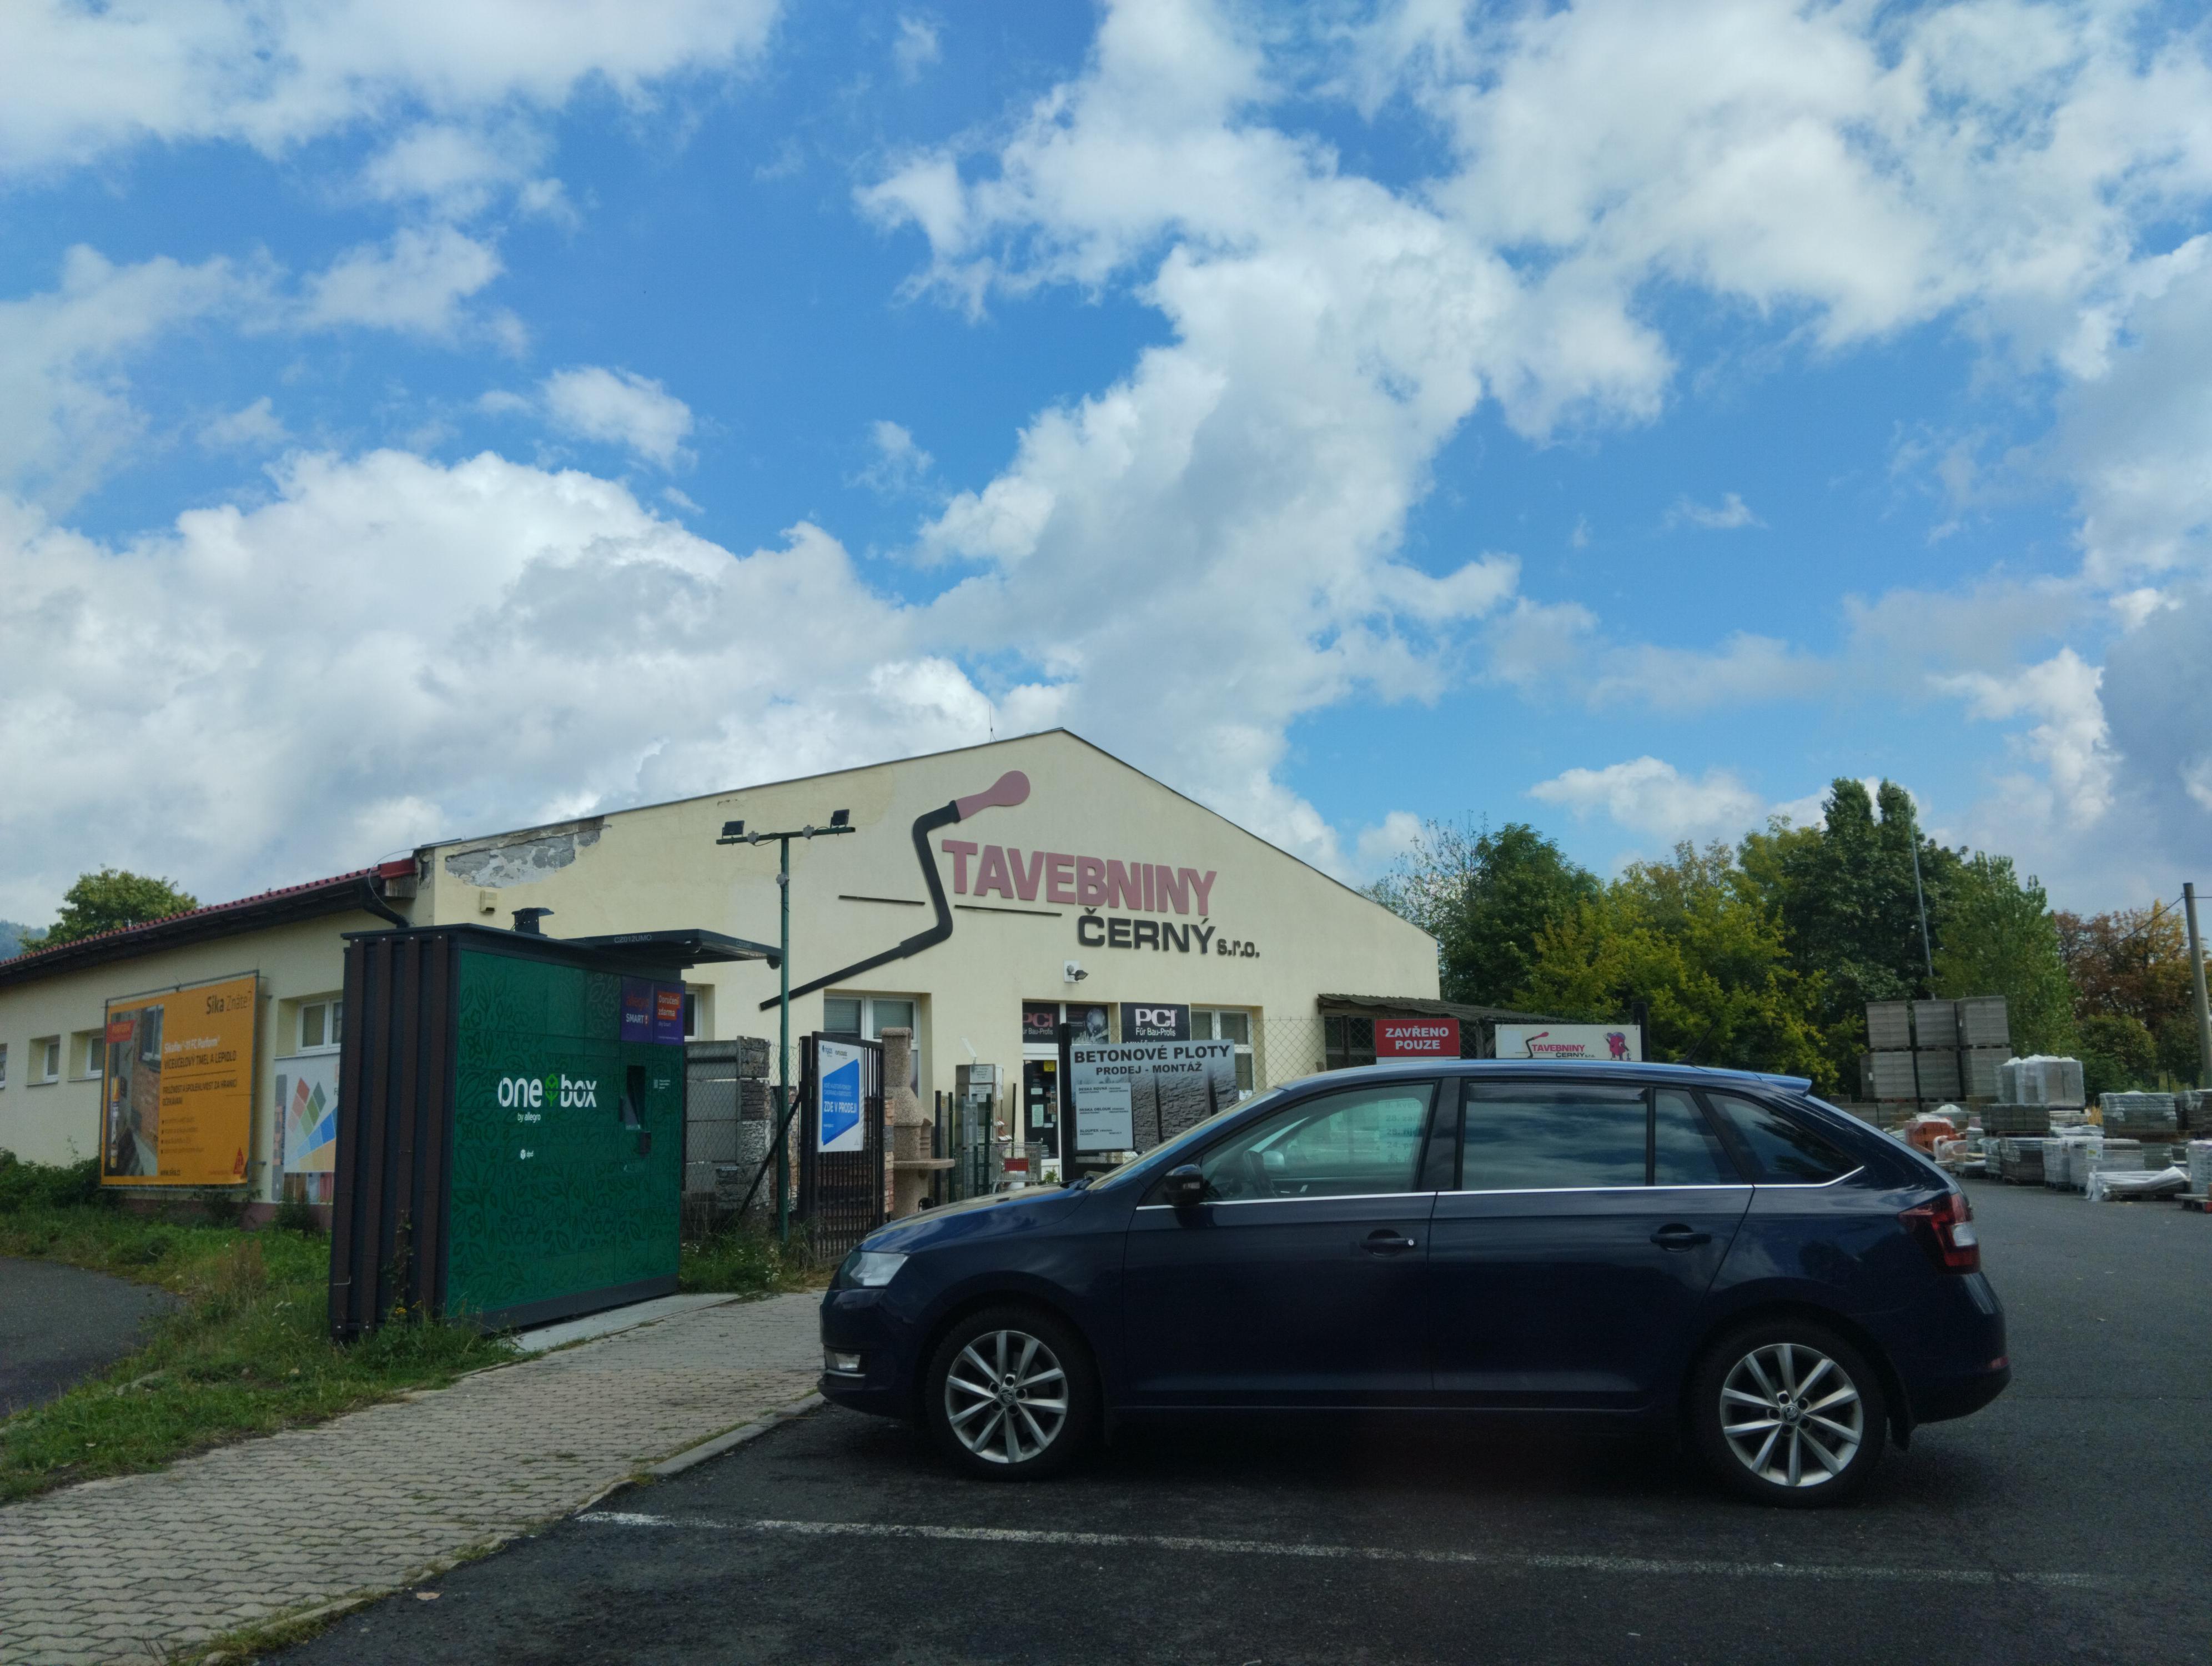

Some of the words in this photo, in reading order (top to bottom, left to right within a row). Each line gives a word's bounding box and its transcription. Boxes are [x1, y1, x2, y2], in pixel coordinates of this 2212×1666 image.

[1077, 907, 1216, 954] ČERNÝ
[1216, 937, 1261, 958] s.r.o.
[206, 994, 224, 1015] Sika
[658, 995, 680, 1006] Doručení
[658, 1007, 676, 1017] zdarma
[1135, 1027, 1146, 1036] Für
[1147, 1027, 1176, 1037] Bau-Profis
[1385, 1025, 1449, 1038] ZAVŘENO
[1395, 1040, 1441, 1050] POUZE
[215, 1050, 237, 1063] LEPIDLO
[1074, 1045, 1168, 1063] BETONOVÉ
[1173, 1045, 1230, 1060] PLOTY
[1096, 1065, 1142, 1076] PRODEJ
[1152, 1061, 1203, 1073] MONTÁŽ
[498, 1077, 543, 1108] one
[560, 1074, 597, 1108] box
[823, 1101, 833, 1113] ZDE
[834, 1101, 838, 1113] V
[517, 1112, 524, 1123] by
[524, 1111, 541, 1123] allegro
